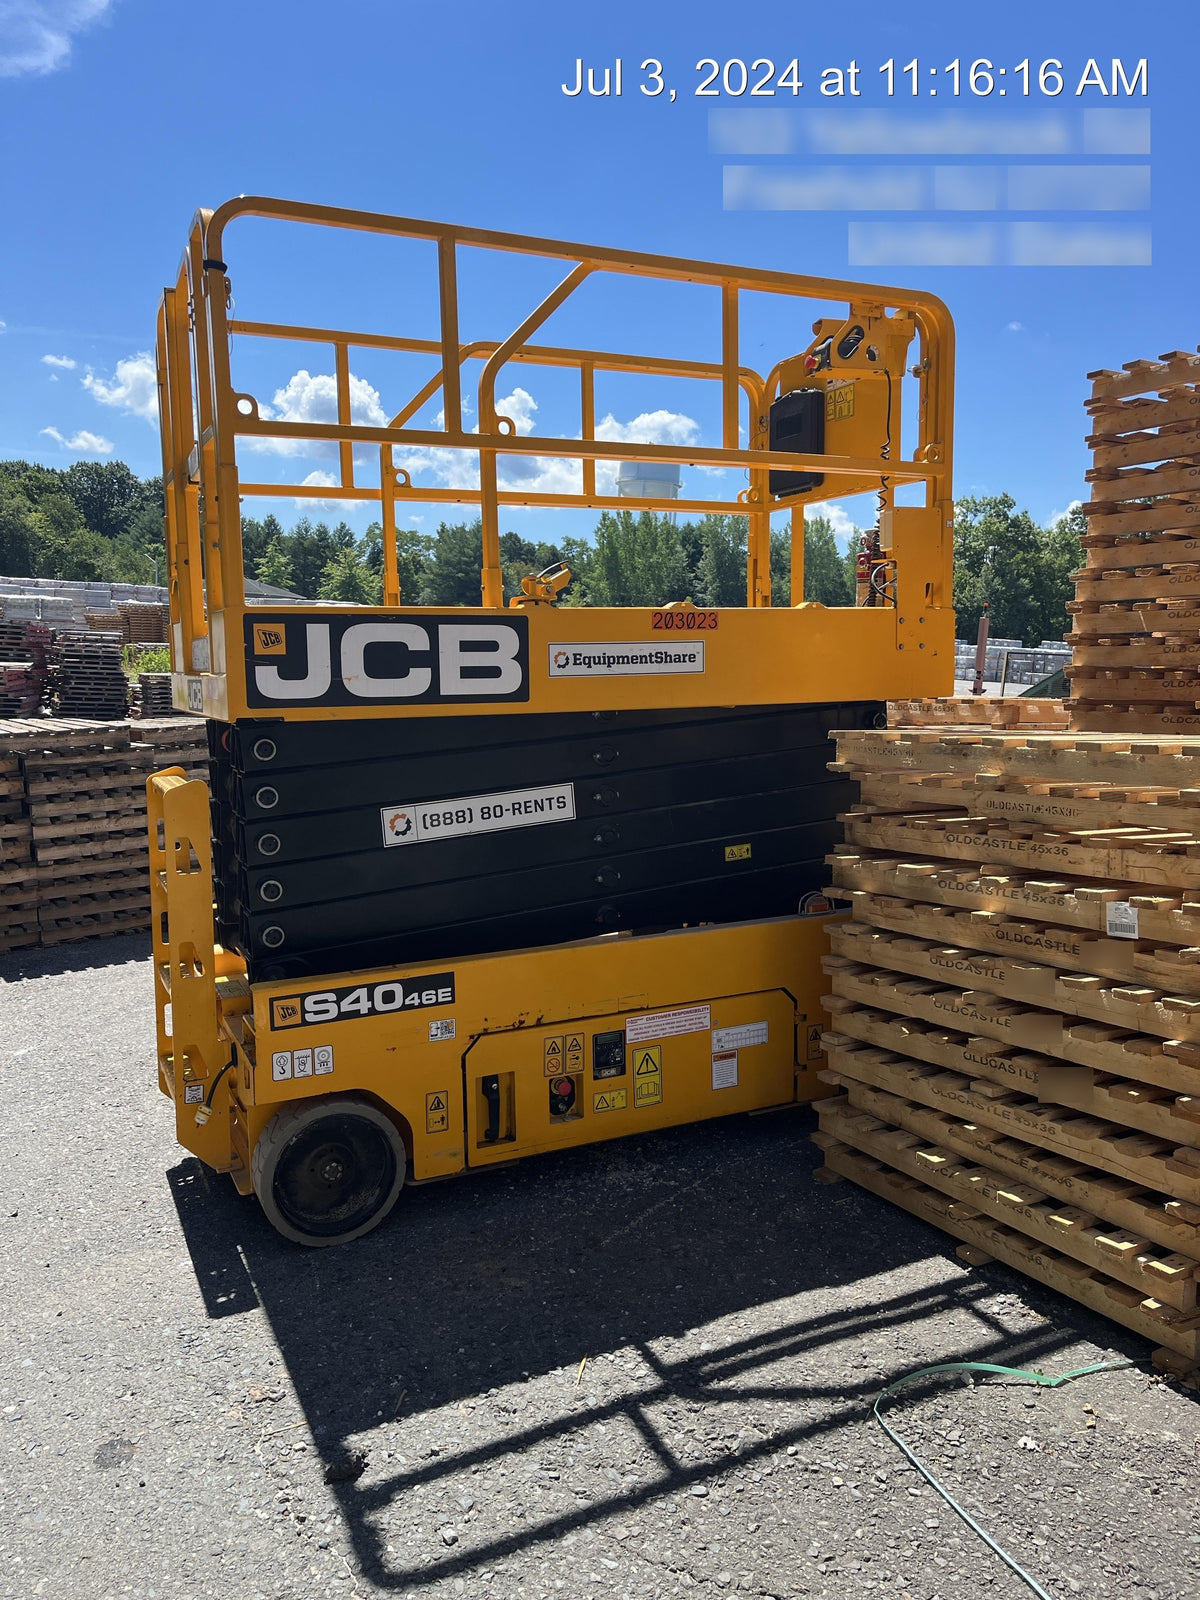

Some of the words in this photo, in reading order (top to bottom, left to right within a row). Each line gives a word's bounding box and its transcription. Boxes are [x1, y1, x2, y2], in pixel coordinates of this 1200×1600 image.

[653, 612, 718, 629] 203023
[262, 631, 281, 647] JCB
[254, 623, 522, 699] JCB
[572, 651, 696, 669] EquipmentShare
[888, 704, 932, 712] OLDCASTLE
[480, 795, 567, 820] 80-RENTS
[946, 833, 1026, 851] OLDCASTLE
[938, 880, 1020, 899] OLDCASTLE
[995, 929, 1080, 955] OLDCASTLE
[929, 957, 1005, 981] OLDCASTLE
[280, 1005, 298, 1020] JCB
